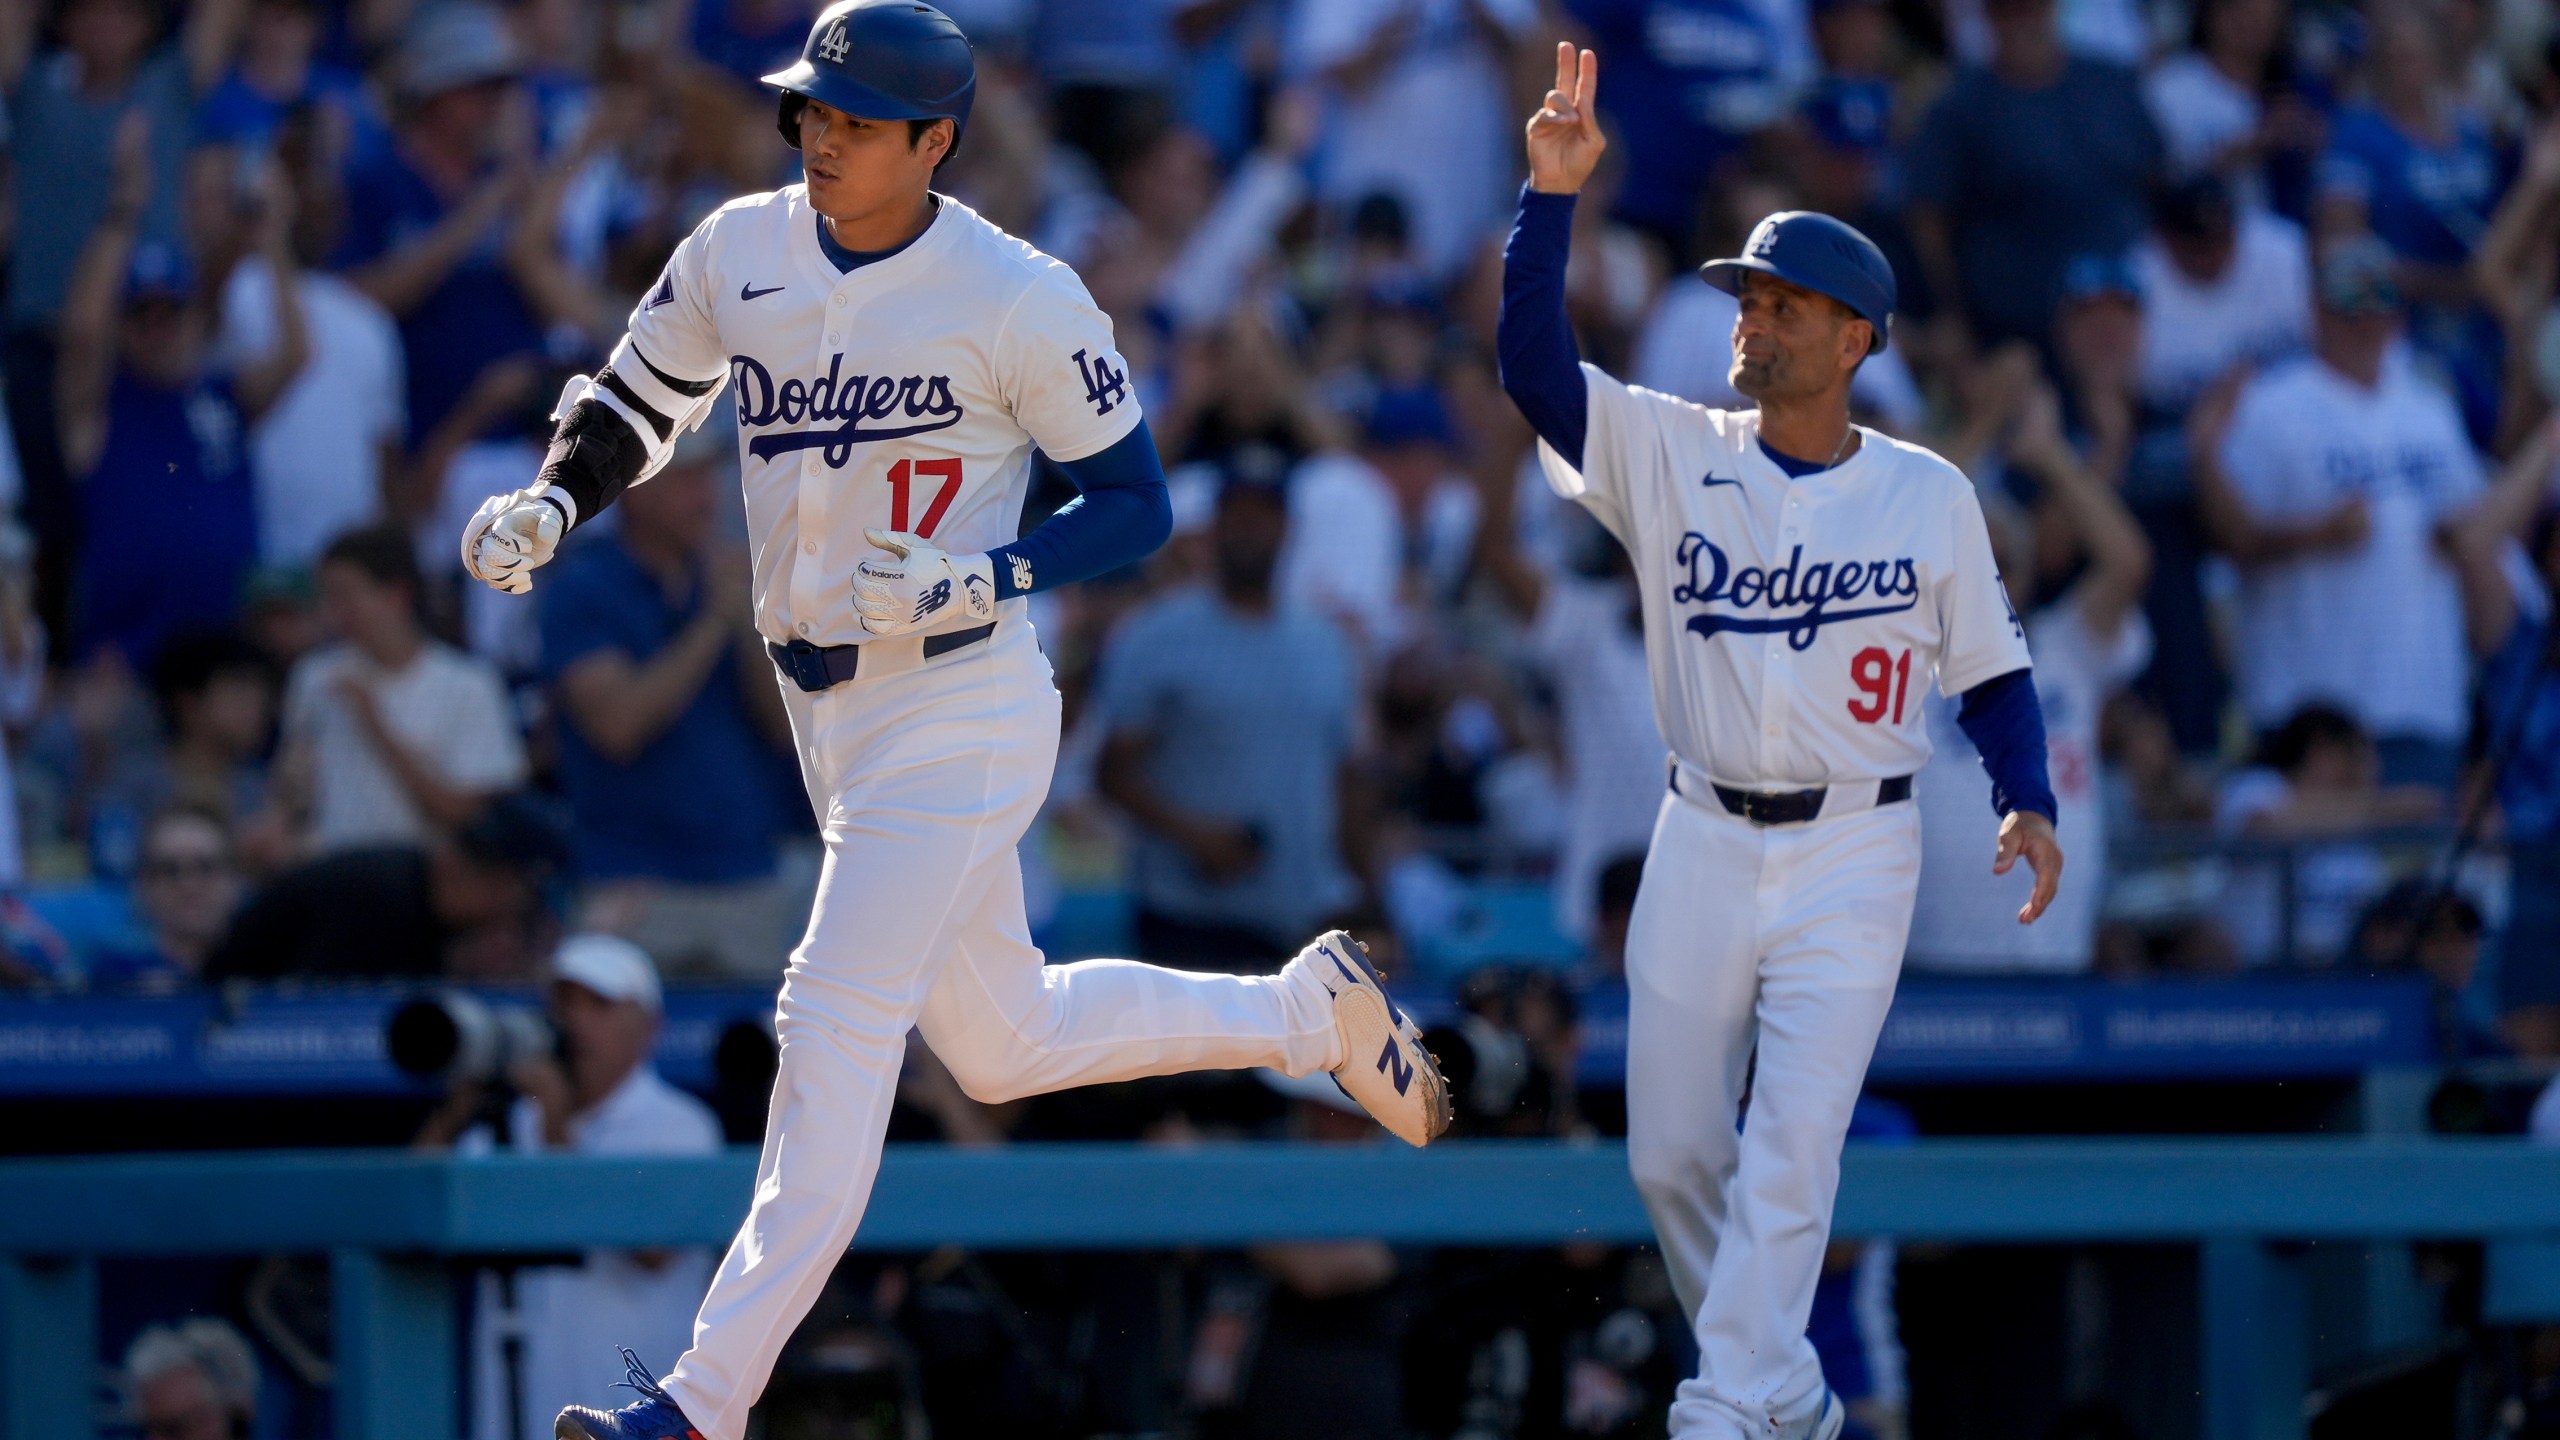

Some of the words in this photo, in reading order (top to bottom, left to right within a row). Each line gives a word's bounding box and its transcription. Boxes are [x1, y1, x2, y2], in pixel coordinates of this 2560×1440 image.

[818, 15, 851, 64] LA
[731, 353, 963, 469] Dodgers
[1071, 348, 1126, 416] LA
[887, 458, 963, 539] 17
[871, 569, 905, 580] balance
[1674, 531, 1918, 652] Dodgers
[1847, 646, 1911, 724] 91
